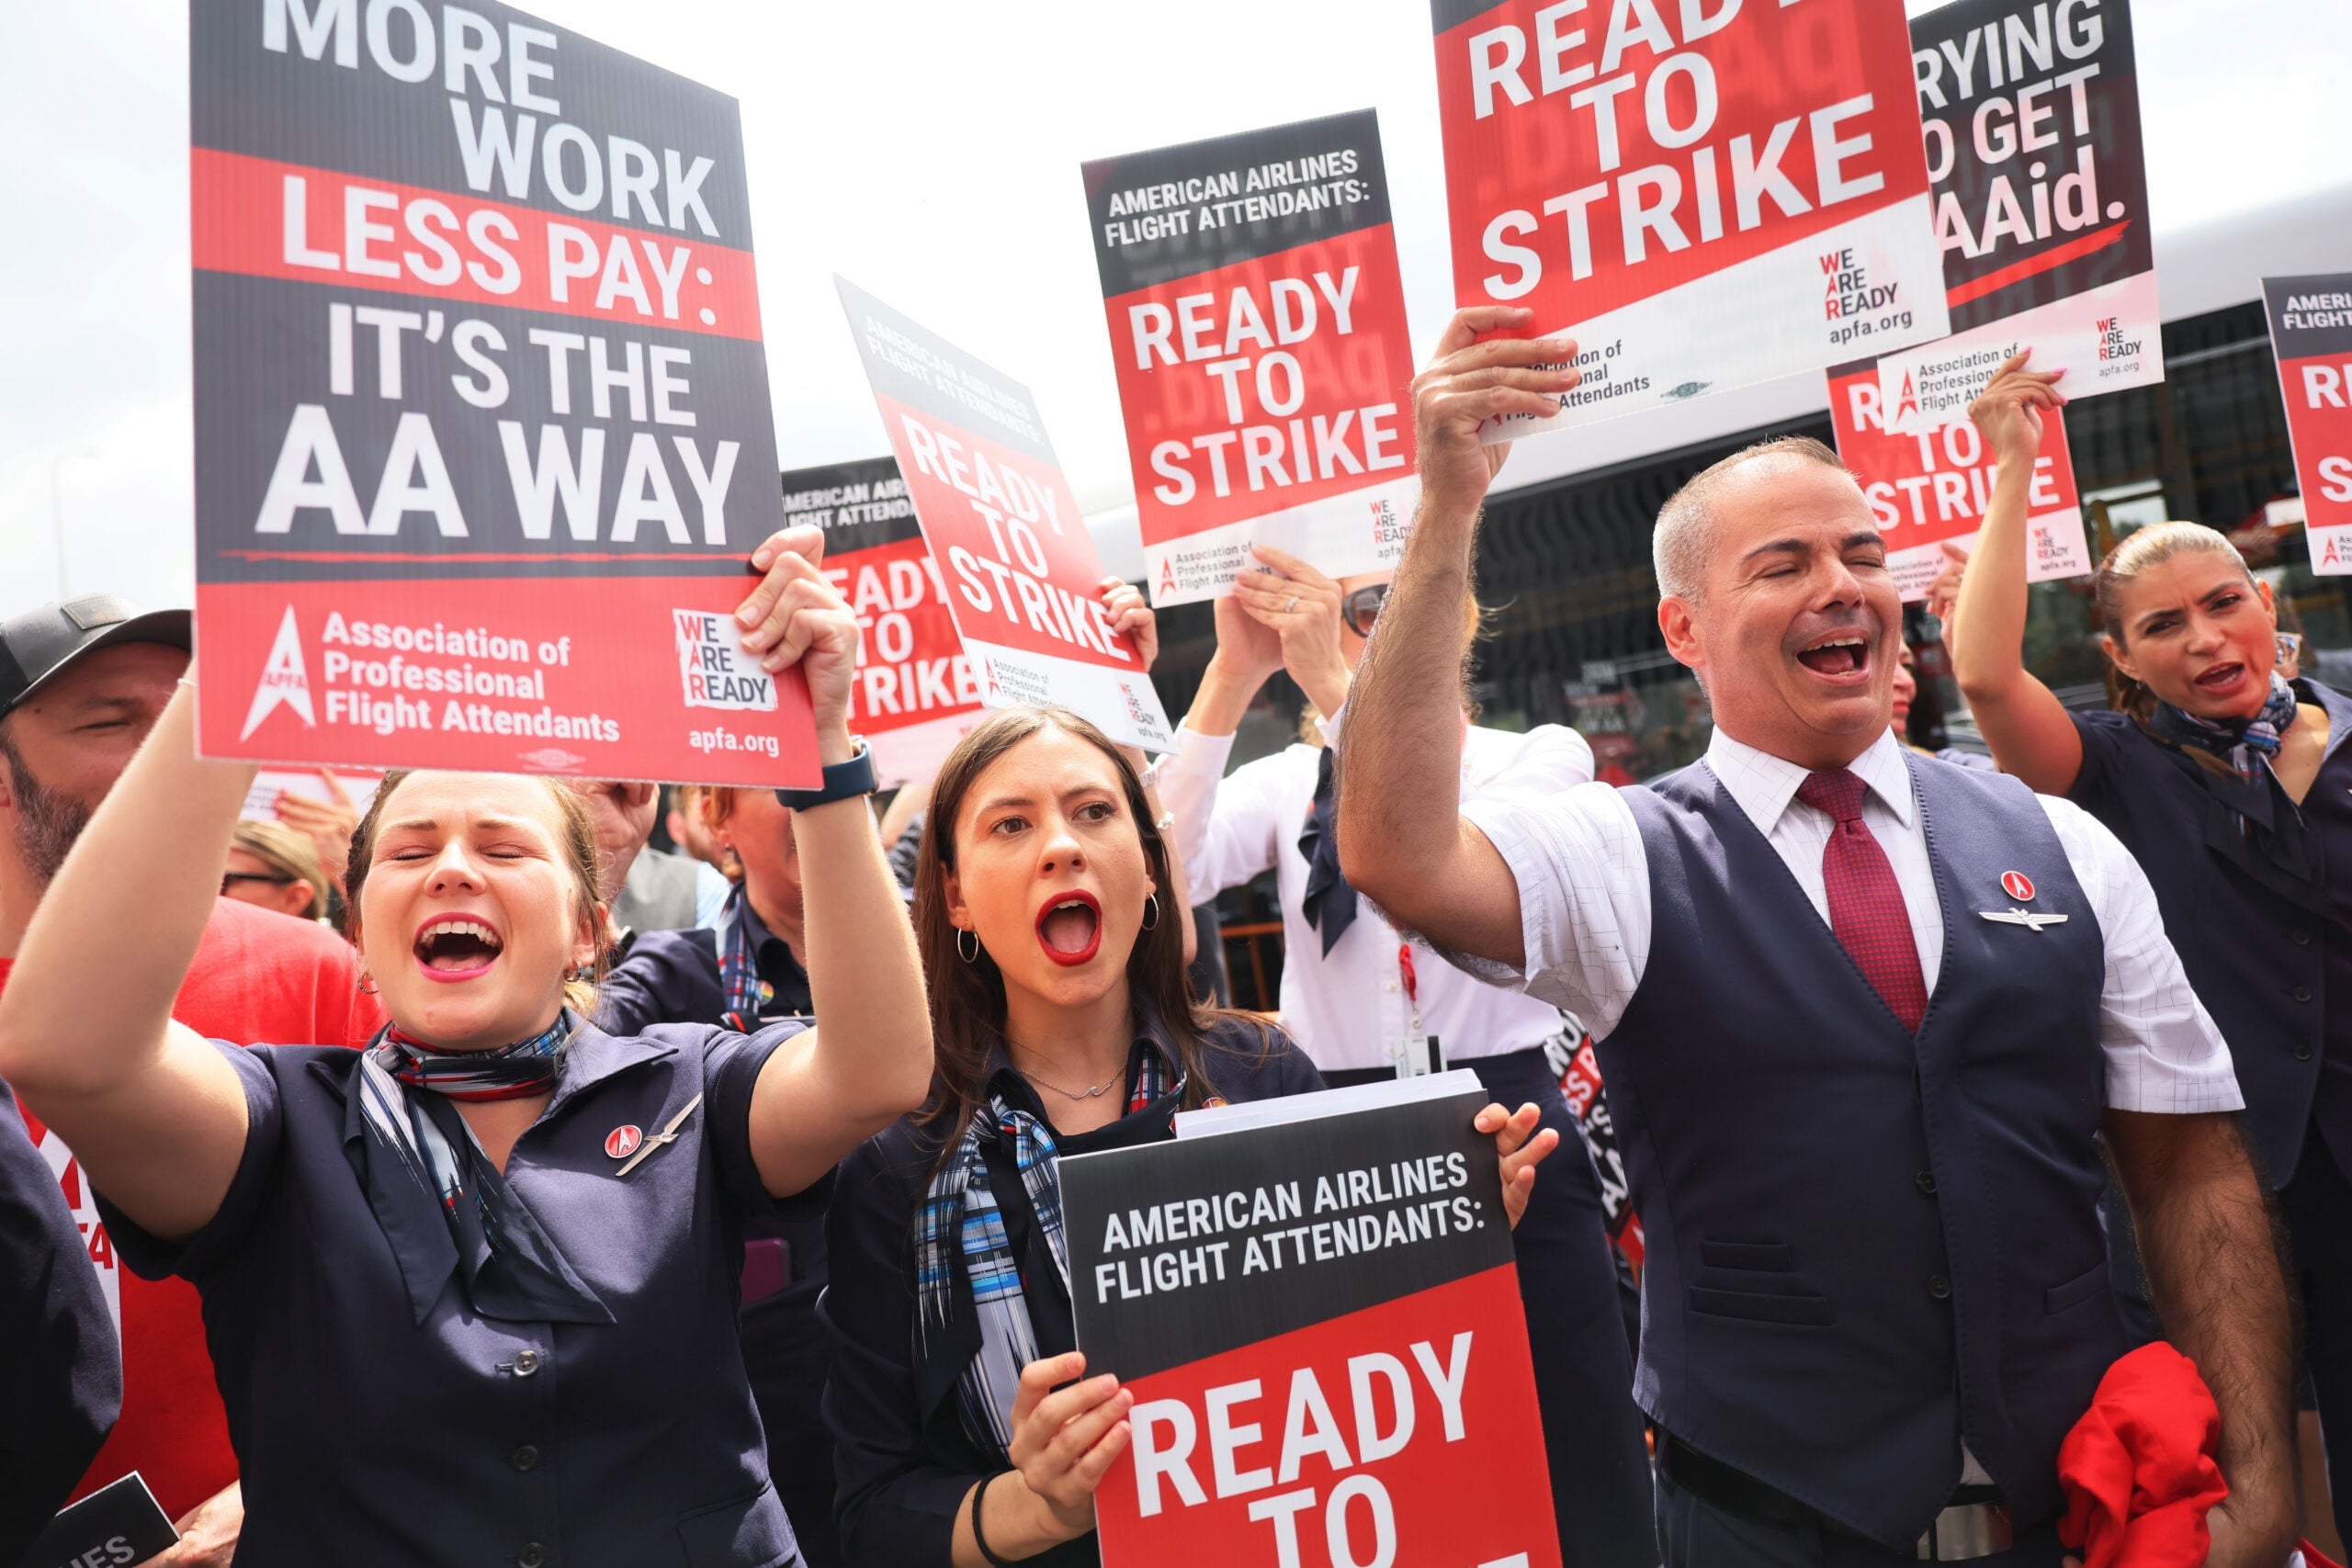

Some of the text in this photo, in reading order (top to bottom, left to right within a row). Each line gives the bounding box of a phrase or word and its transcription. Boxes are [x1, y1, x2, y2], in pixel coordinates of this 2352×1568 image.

[263, 0, 560, 117] MORE
[1468, 0, 1815, 120] READ
[1912, 0, 2104, 114] RYING
[1570, 51, 1719, 175] TO
[1922, 62, 2101, 185] O GET
[449, 96, 720, 239] WORK
[1108, 148, 1359, 219] AMERICAN AIRLINES
[1481, 92, 1885, 301] STRIKE
[1103, 177, 1372, 248] FLIGHT ATTENDANTS:
[1934, 143, 2126, 260] AAid.
[282, 174, 718, 327] LESS PAY:
[1819, 247, 1855, 275] WE
[1825, 267, 1867, 299] ARE
[1128, 265, 1361, 371] READY
[1825, 282, 1898, 321] READY
[1829, 310, 1913, 345] apfa.org
[2097, 317, 2117, 333] WE
[528, 327, 697, 427] THE
[866, 315, 958, 382] AMERICAN
[866, 333, 932, 385] FLIGHT
[1605, 339, 1622, 358] of
[1918, 343, 2018, 378] Association of
[2099, 340, 2142, 361] READY
[1205, 351, 1306, 425] TO
[1559, 376, 1651, 410] Attendants
[1921, 391, 1961, 412] Flight
[254, 402, 741, 547] AA WAY
[899, 412, 1064, 537] READY
[1148, 401, 1406, 507] STRIKE
[1905, 419, 1983, 472] TO
[784, 478, 909, 513] MERICAN AIR
[1864, 456, 2061, 531] STRIE
[970, 499, 1049, 580] TO
[1175, 545, 1239, 563] Association
[1176, 556, 1245, 576] Professional
[1374, 525, 1411, 544] READ
[821, 556, 948, 615] EADY
[948, 545, 1132, 662] STRIKE
[1178, 576, 1210, 591] Flight
[322, 610, 571, 667] Association of
[679, 614, 719, 644] WE
[688, 641, 734, 672] ARE
[323, 649, 546, 700] Professional
[688, 673, 768, 705] READY
[846, 654, 981, 720] TRIKE
[325, 690, 621, 742] Flight Attendants
[689, 726, 780, 759] apfa.org
[1102, 1151, 1469, 1254] AMERICAN AIRLINES
[1095, 1196, 1486, 1304] FLIGHT ATTENDANTS:
[1128, 1330, 1474, 1519] READY
[1248, 1473, 1398, 1568] TO
